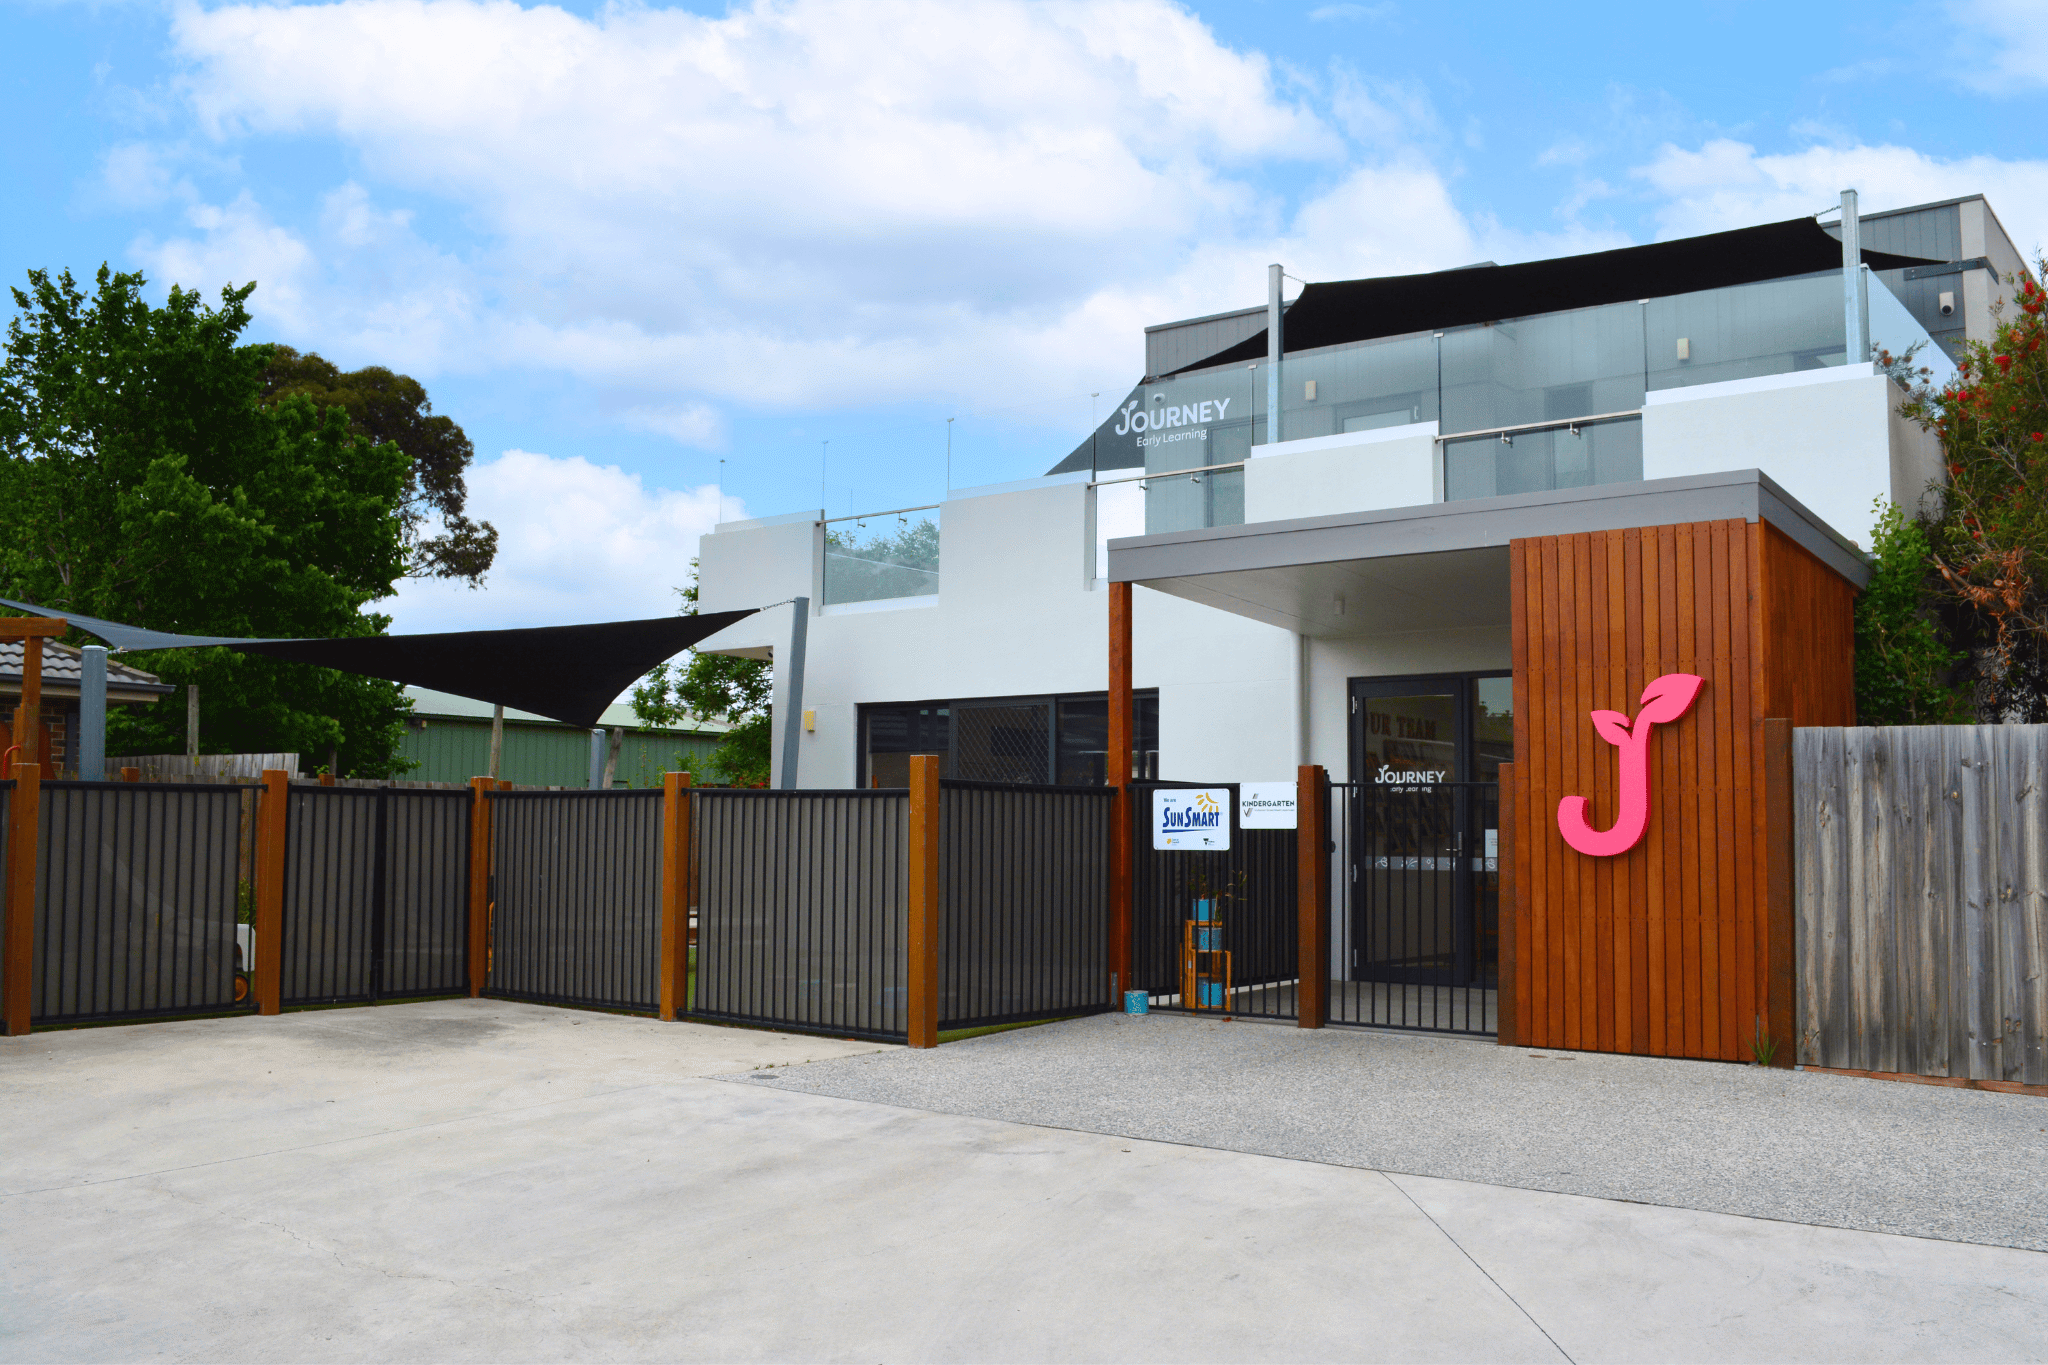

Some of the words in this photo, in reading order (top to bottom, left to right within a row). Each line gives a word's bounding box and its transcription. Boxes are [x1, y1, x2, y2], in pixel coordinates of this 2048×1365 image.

[1115, 398, 1231, 436] JOURNEY
[1136, 434, 1161, 447] Early
[1163, 428, 1208, 443] Learning
[1374, 764, 1446, 784] JOURNEY
